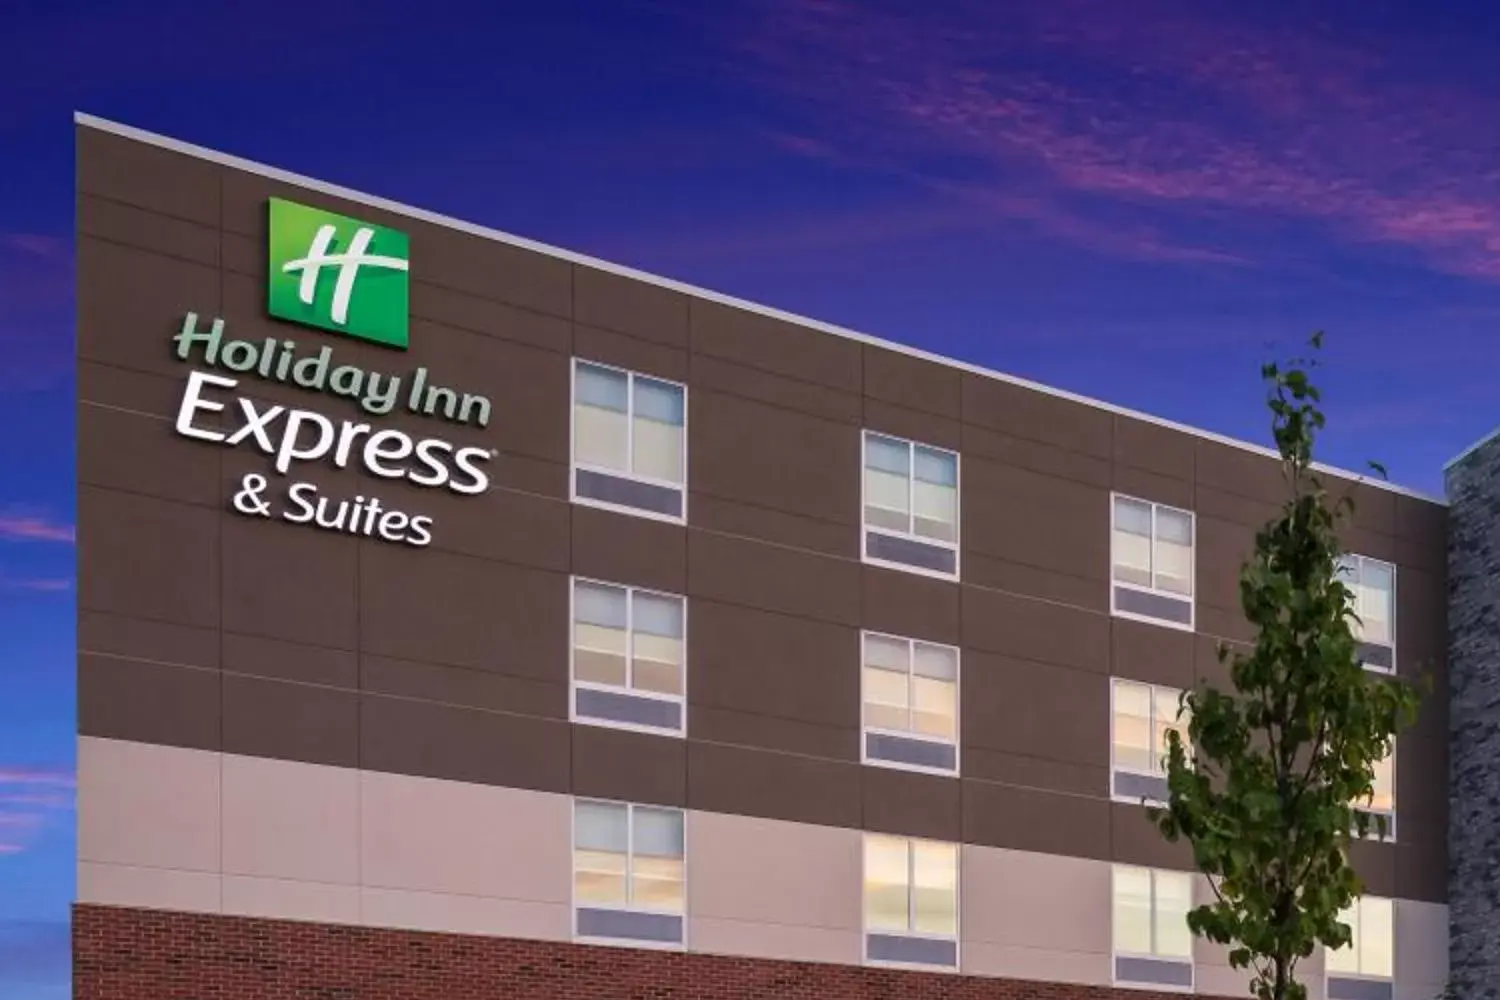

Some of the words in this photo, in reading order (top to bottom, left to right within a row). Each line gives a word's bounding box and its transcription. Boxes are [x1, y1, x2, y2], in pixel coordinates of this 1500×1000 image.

[173, 312, 400, 414] Holiday
[409, 367, 492, 426] Inn
[175, 371, 491, 495] Express
[233, 473, 270, 516] &
[283, 482, 433, 546] Suites
